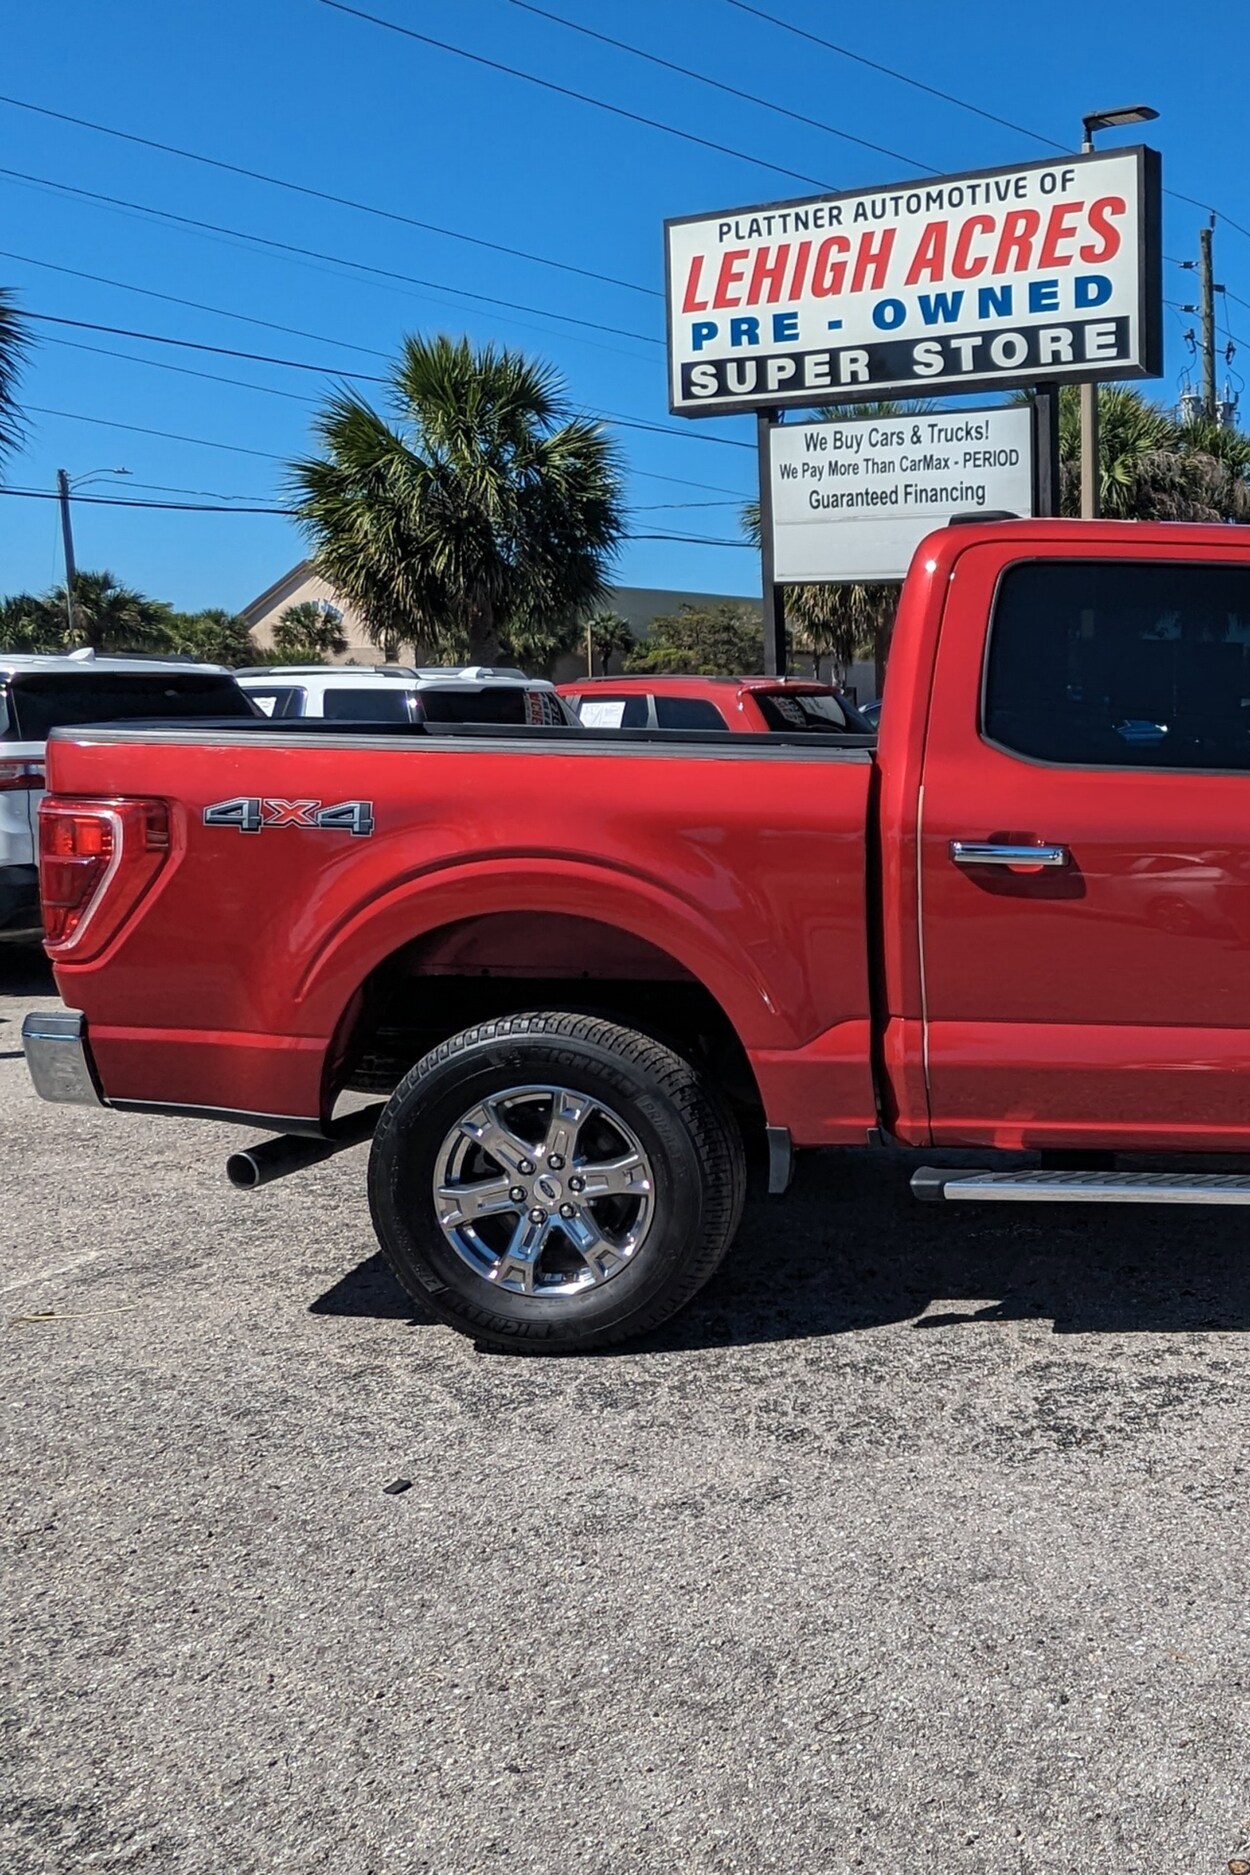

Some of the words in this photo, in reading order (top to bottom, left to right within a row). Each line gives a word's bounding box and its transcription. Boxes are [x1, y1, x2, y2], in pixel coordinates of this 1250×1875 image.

[718, 205, 843, 243] PLATTNER
[853, 176, 1028, 224] AUTOMOTIVE
[1039, 168, 1076, 195] OF
[682, 228, 897, 313] LEHIGH
[904, 196, 1127, 286] ACRES
[691, 312, 801, 351] PRE
[872, 275, 1113, 331] OWNED
[690, 349, 870, 397] SUPER
[912, 322, 1119, 376] STORE
[779, 463, 798, 480] We
[802, 462, 824, 481] Pay
[828, 459, 860, 477] More
[863, 457, 896, 474] Than
[899, 453, 950, 472] CarMax
[963, 449, 1020, 469] PERIOD
[804, 431, 828, 452] We
[833, 430, 864, 454] Buy
[868, 427, 905, 448] Cars
[910, 424, 922, 445] &
[928, 420, 990, 444] Trucks!
[808, 484, 899, 510] Guaranteed
[904, 480, 986, 505] Financing
